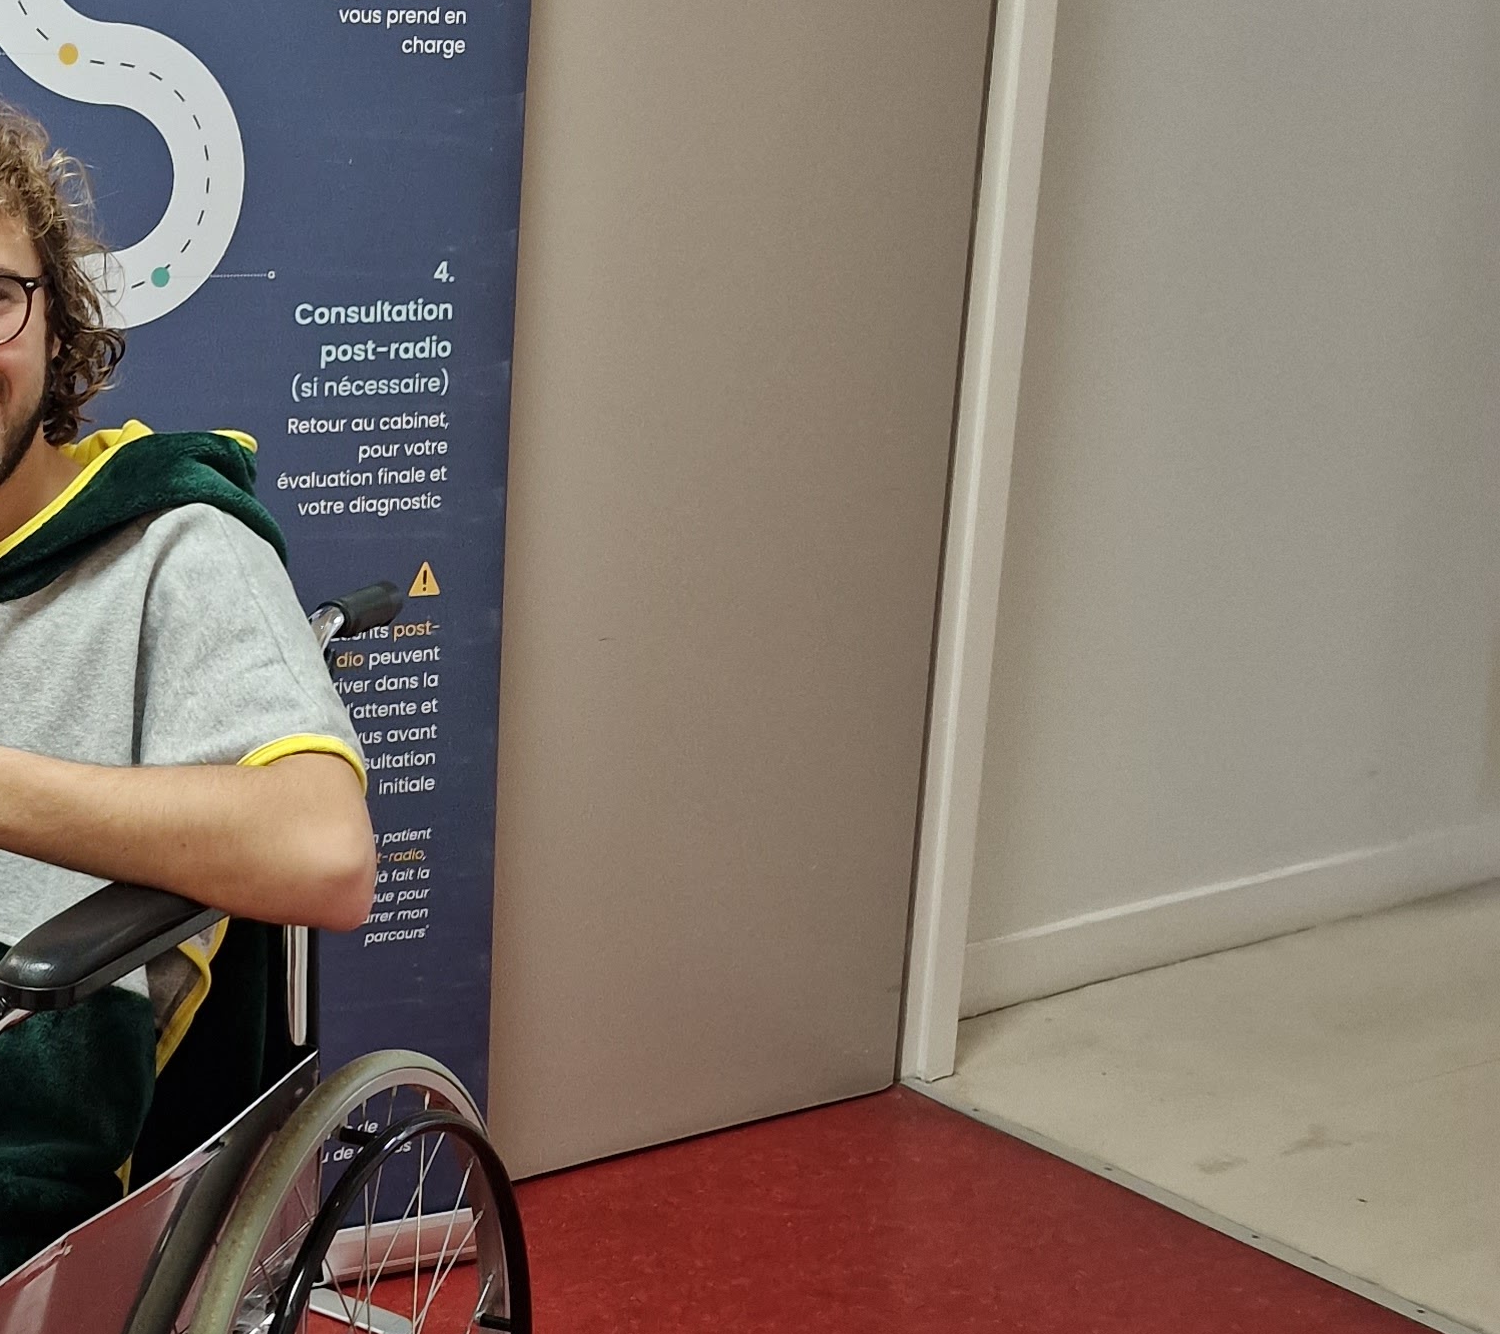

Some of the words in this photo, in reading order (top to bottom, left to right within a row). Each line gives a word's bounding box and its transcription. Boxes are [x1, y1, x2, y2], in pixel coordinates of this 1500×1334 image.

[339, 8, 381, 24] vous
[387, 7, 440, 28] prend
[444, 10, 467, 25] en
[401, 36, 466, 58] charge
[434, 261, 455, 283] 4.
[295, 298, 452, 325] Consultation
[321, 335, 451, 368] post-radio
[291, 374, 318, 402] (si
[325, 368, 449, 397] nécessaire)
[287, 416, 346, 435] Retour
[351, 417, 374, 431] au
[379, 411, 449, 431] cabinet,
[358, 442, 399, 463] pour
[404, 439, 448, 456] votre
[277, 468, 372, 490] évaluation
[378, 467, 425, 485] finale
[430, 466, 447, 481] et
[297, 498, 344, 516] votre
[349, 492, 442, 517] diagnostic
[393, 621, 440, 642] post-
[336, 651, 364, 668] dio
[369, 646, 440, 670] peuvent
[375, 675, 418, 692] dans
[423, 672, 438, 688] la
[421, 698, 438, 714] et
[387, 724, 437, 743] avant
[364, 751, 436, 770] sultation
[379, 776, 435, 795] initiale
[382, 827, 432, 847] patient
[391, 868, 414, 882] fait
[417, 867, 430, 879] la
[397, 888, 431, 905] pour
[397, 908, 428, 921] mon
[333, 1146, 354, 1162] de
